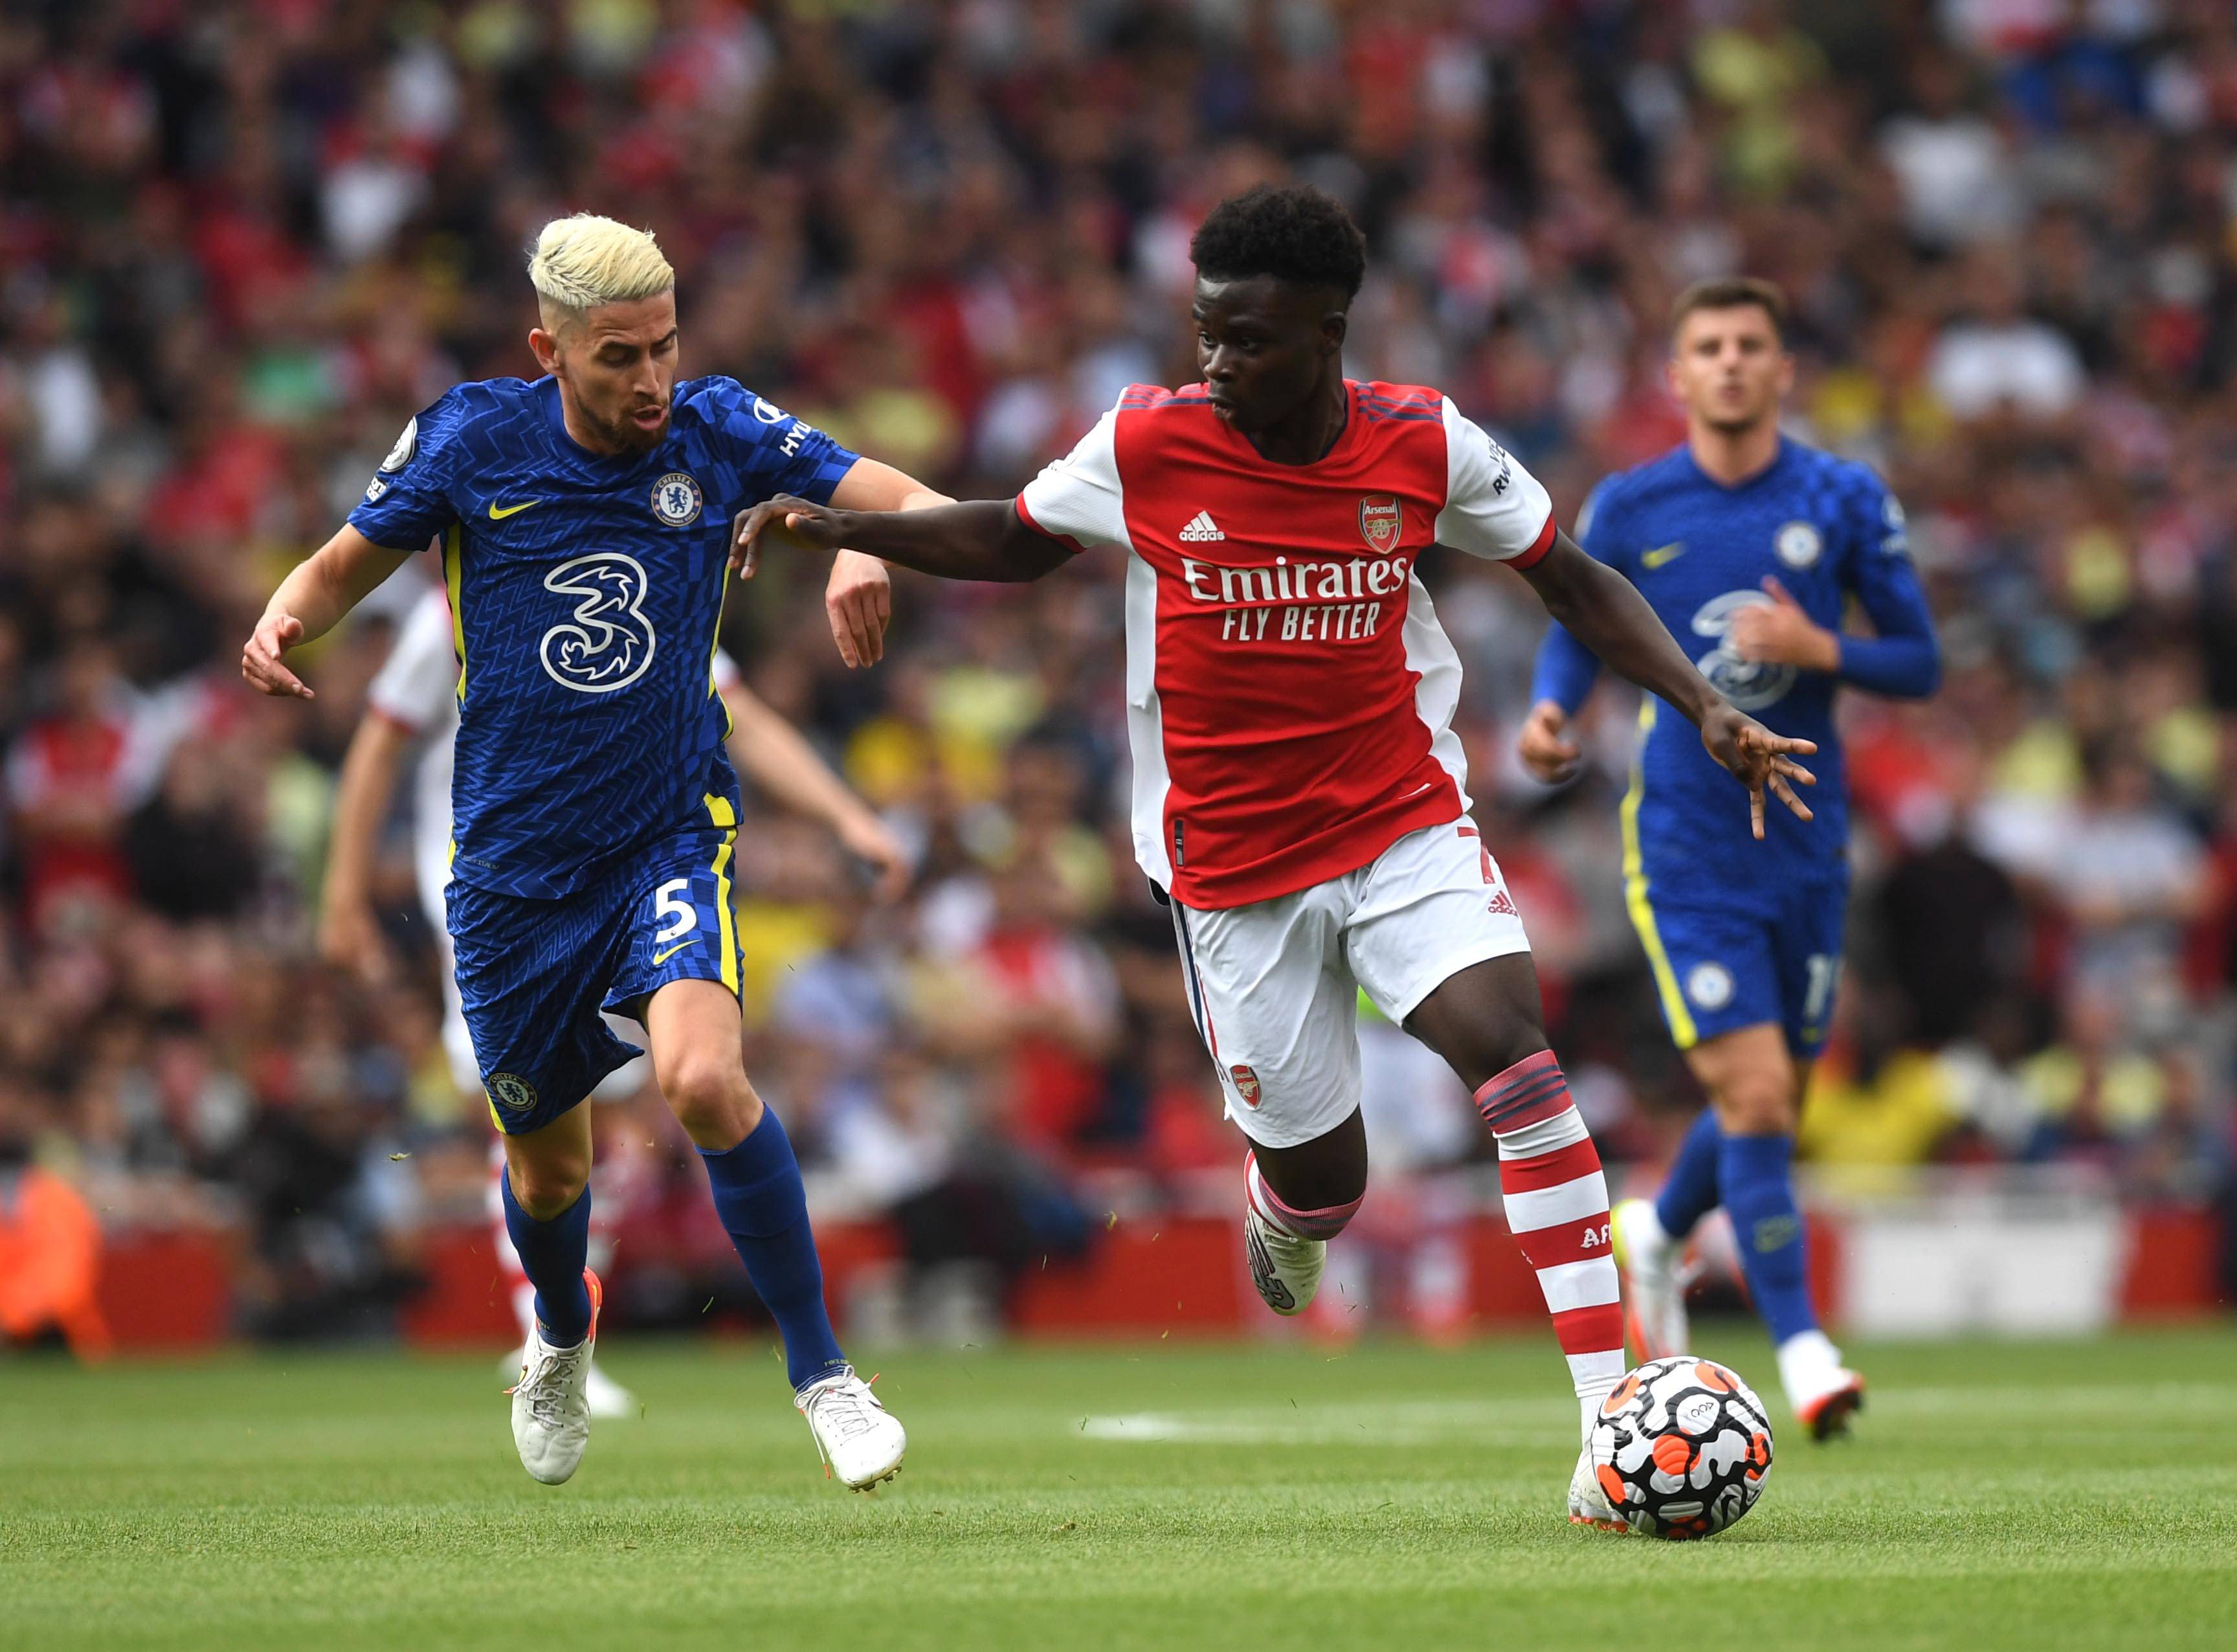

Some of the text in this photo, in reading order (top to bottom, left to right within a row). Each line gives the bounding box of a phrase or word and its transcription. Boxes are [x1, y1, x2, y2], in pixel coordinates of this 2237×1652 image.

[658, 475, 691, 488] CHELSEA
[1364, 504, 1395, 515] Arsenal
[1179, 531, 1225, 542] adidas
[1181, 556, 1407, 603] Emirates
[1222, 602, 1380, 641] FLY BETTER
[656, 878, 697, 943] 5
